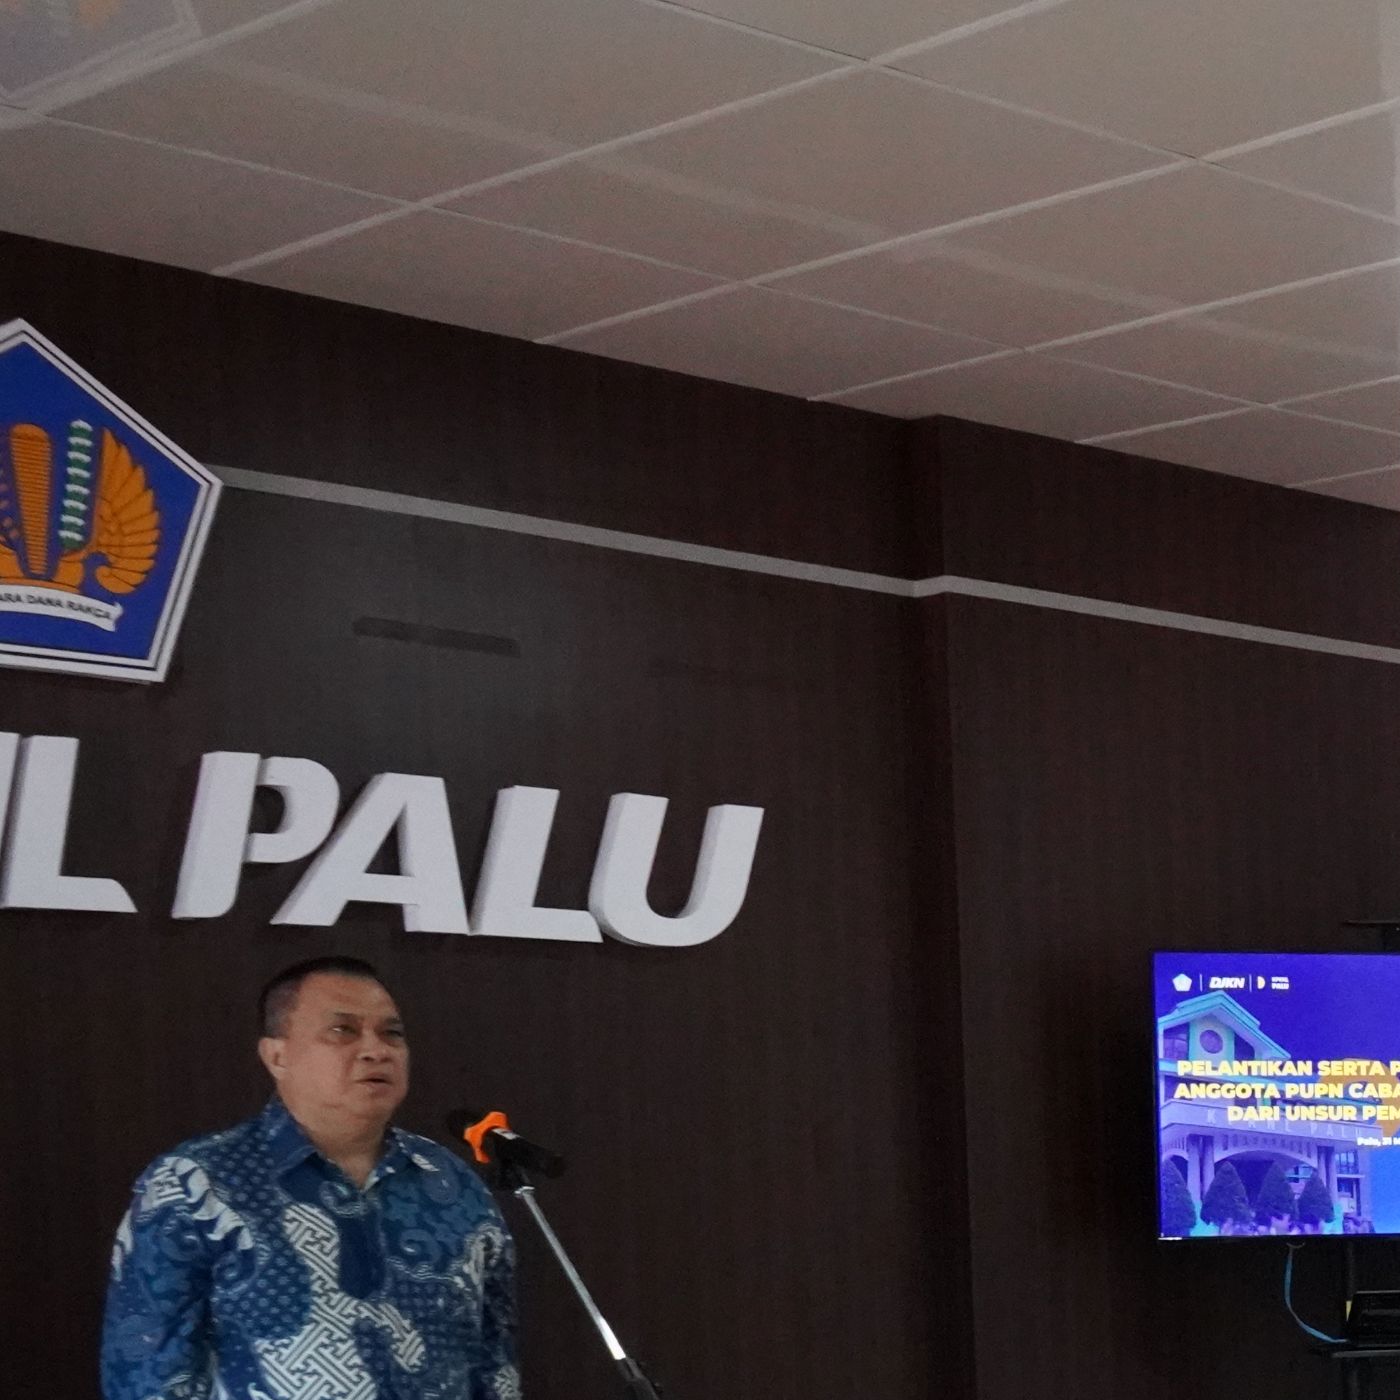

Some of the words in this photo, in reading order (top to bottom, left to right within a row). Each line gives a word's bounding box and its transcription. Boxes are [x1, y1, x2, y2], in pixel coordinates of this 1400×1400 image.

[172, 750, 764, 947] PALU
[1209, 977, 1246, 989] DJKN
[1177, 1060, 1313, 1076] PELANTIKAN
[1318, 1060, 1386, 1076] SERTA
[1174, 1083, 1281, 1098] ANGGOTA
[1285, 1083, 1344, 1098] PUPN
[1227, 1105, 1280, 1121] DARI
[1285, 1105, 1357, 1121] UNSUR
[1357, 1136, 1381, 1147] Palu,
